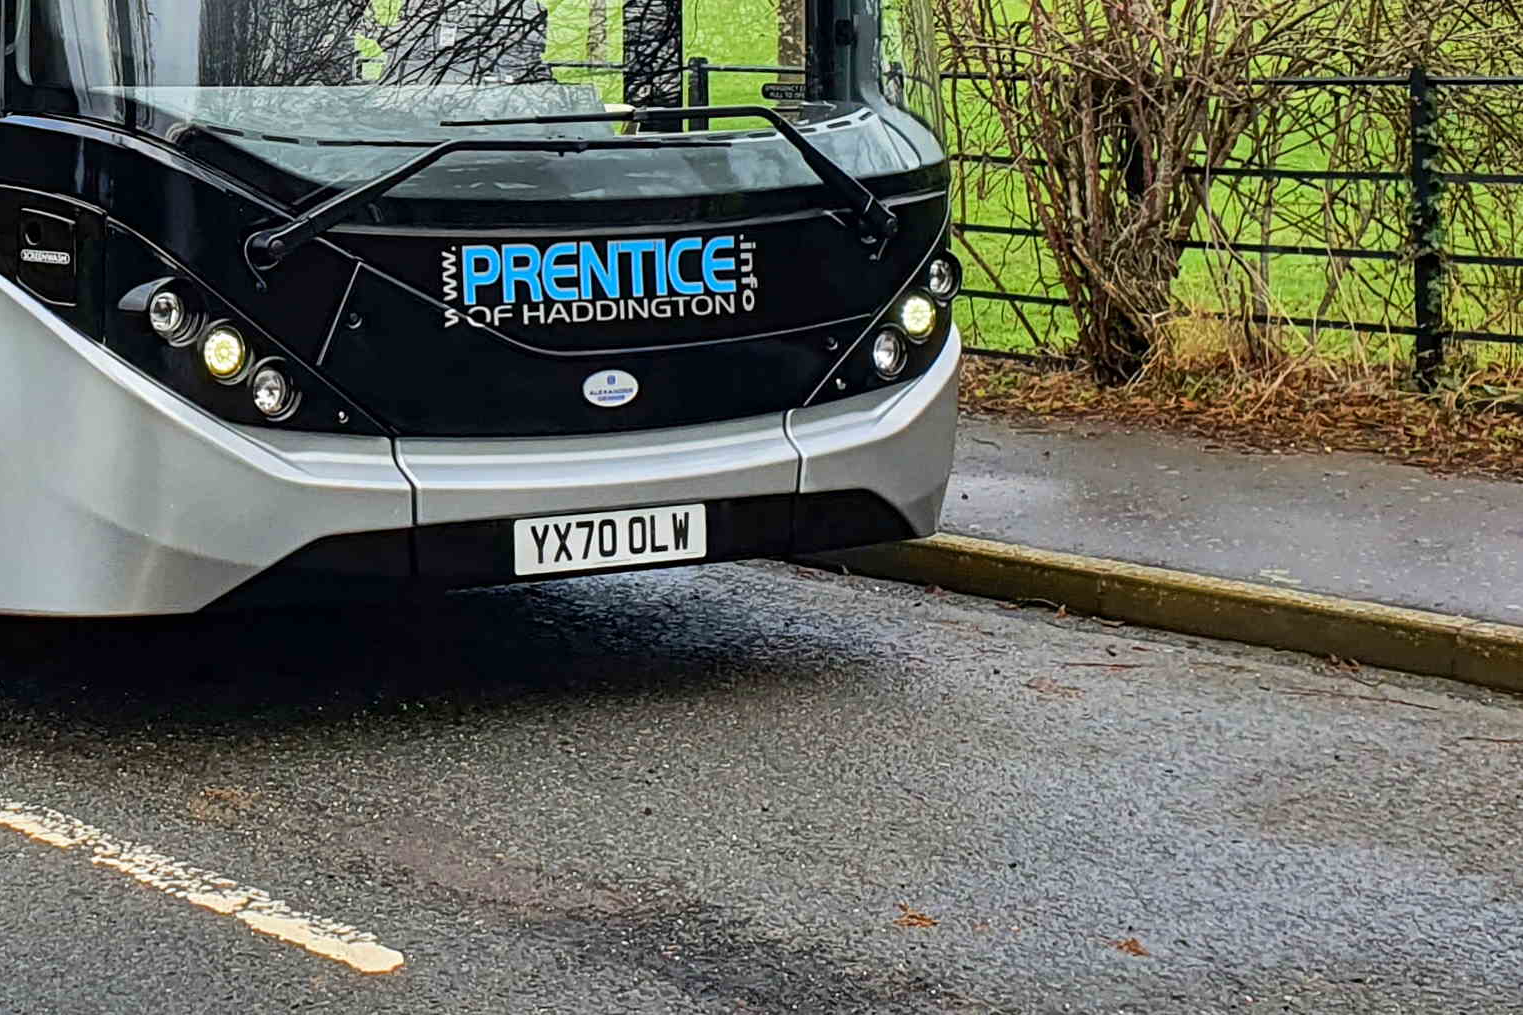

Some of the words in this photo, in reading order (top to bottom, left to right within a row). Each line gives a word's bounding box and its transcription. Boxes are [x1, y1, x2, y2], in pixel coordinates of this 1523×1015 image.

[461, 235, 737, 305] PRENTICE
[467, 305, 513, 327] OF
[523, 294, 735, 326] HADDINGTON
[530, 518, 618, 565] YX70
[628, 511, 690, 555] OLW
